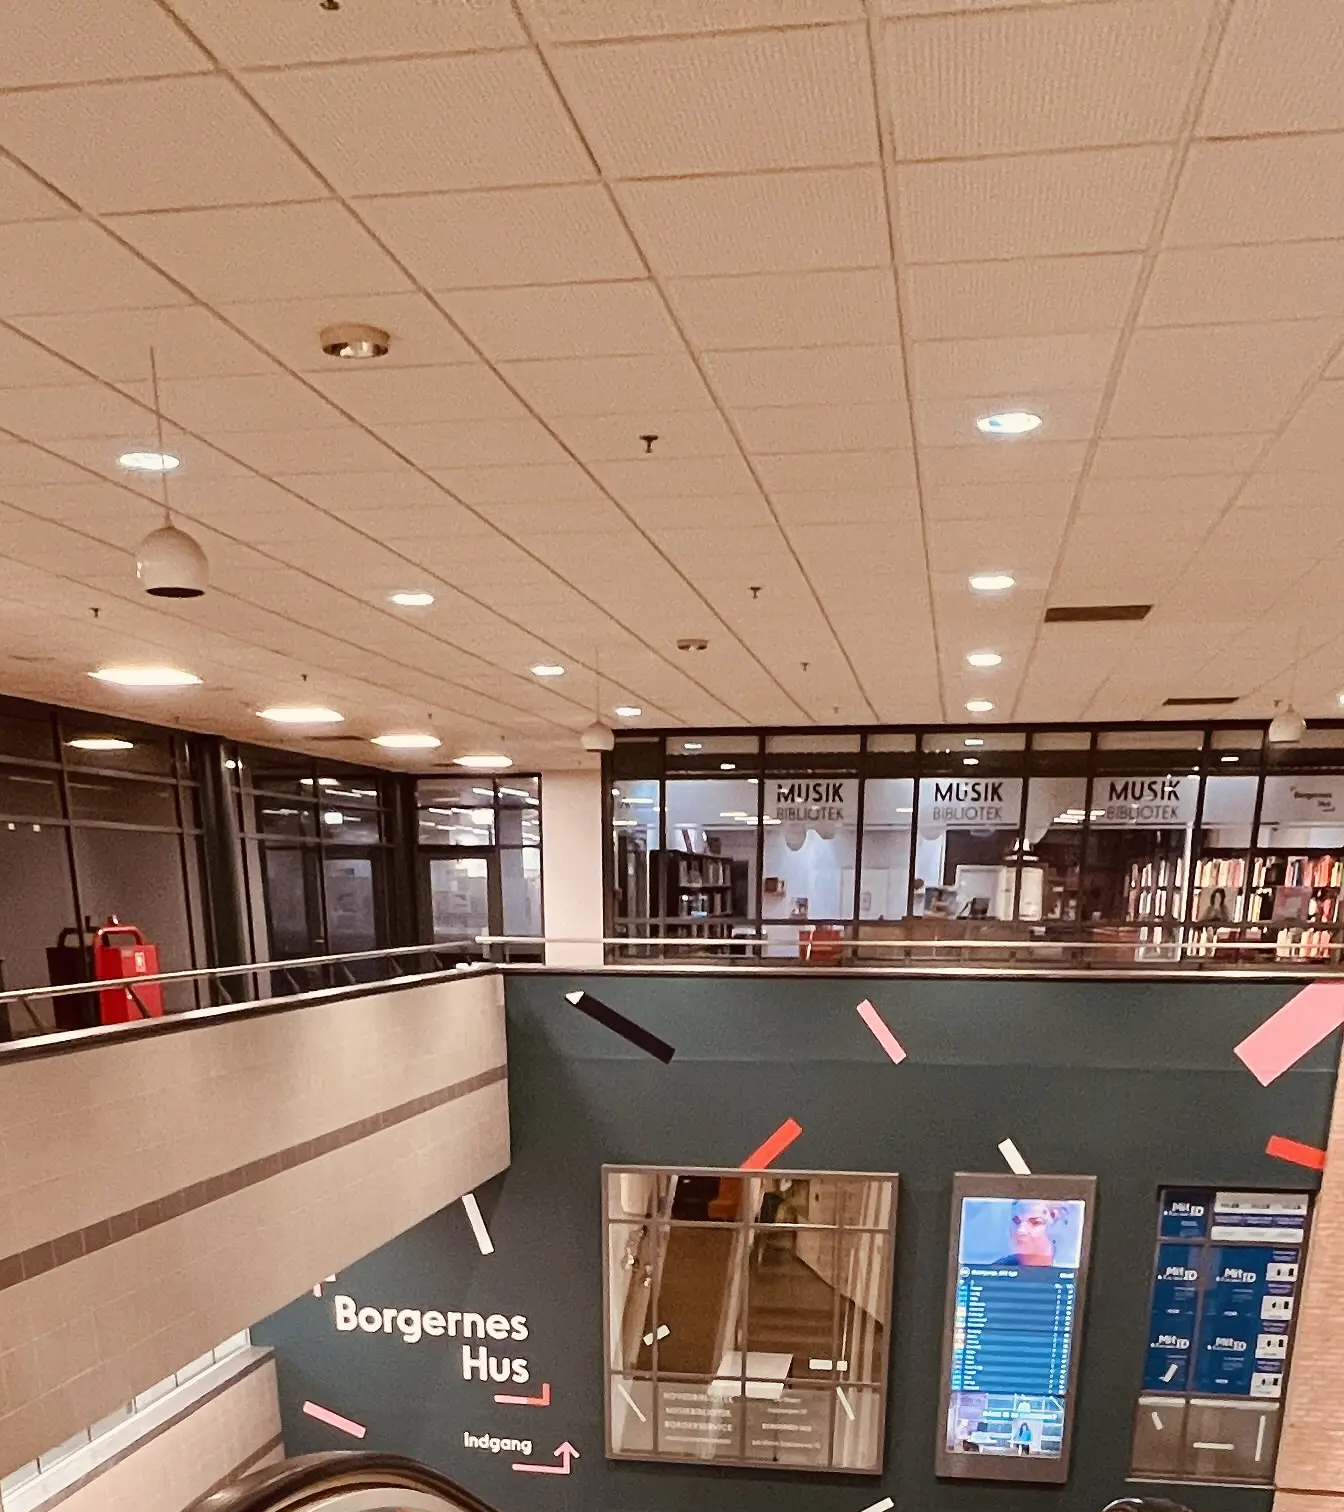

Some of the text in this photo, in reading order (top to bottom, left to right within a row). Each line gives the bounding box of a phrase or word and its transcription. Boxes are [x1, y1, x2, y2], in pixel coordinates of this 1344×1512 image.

[777, 782, 844, 803] MUSIK
[934, 782, 1003, 802] MUSIK
[1108, 780, 1180, 801] MUSIK
[776, 806, 844, 821] BIBLIOTEK
[932, 806, 1003, 821] BIBLIOTEK
[1106, 805, 1179, 820] BIBLIOTEK
[334, 1294, 529, 1343] Borgernes
[462, 1345, 530, 1383] Hus
[464, 1431, 532, 1455] Indgang
